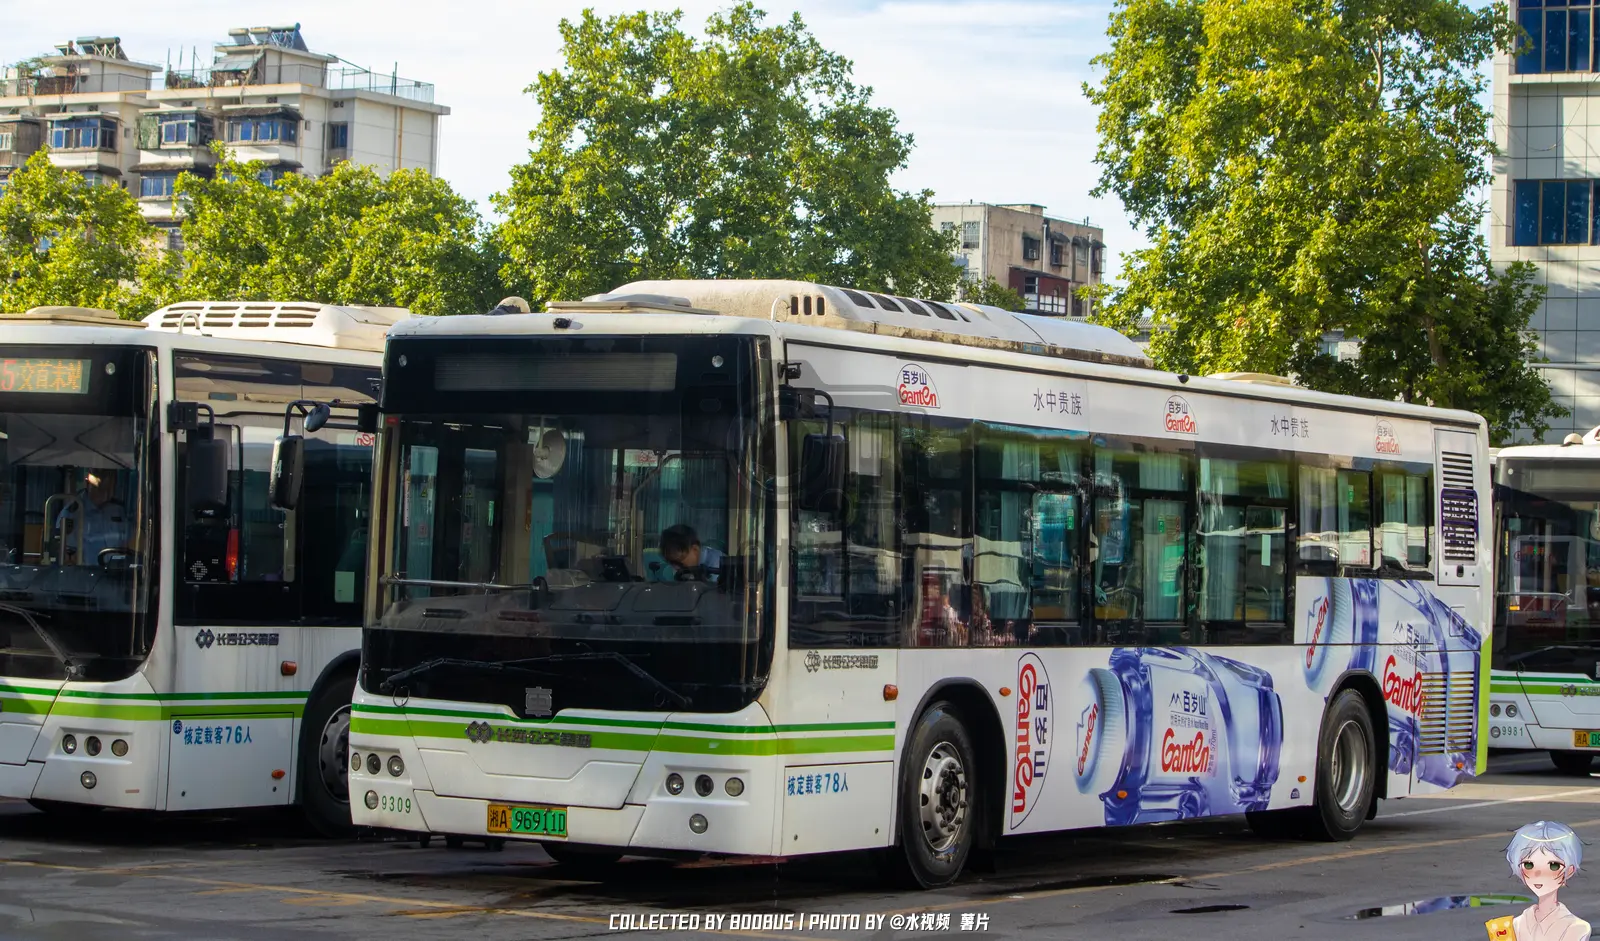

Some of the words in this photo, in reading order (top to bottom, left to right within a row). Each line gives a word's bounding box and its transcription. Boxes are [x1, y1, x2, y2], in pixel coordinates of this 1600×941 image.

[902, 370, 928, 386] 百岁山
[898, 383, 937, 407] Ganten
[1033, 388, 1083, 416] 水中贵族
[1168, 401, 1189, 415] 百岁山
[1165, 413, 1197, 433] Ganten
[1270, 414, 1310, 439] 水中贵族
[1376, 425, 1394, 438] 百岁山
[183, 725, 253, 746] 核定载客76人
[1013, 663, 1037, 814] Ganten
[1033, 683, 1048, 778] 百岁山
[1501, 726, 1524, 737] 9981
[1161, 727, 1210, 773] Ganten
[787, 772, 849, 796] 核定载客78人
[381, 796, 411, 814] 9309
